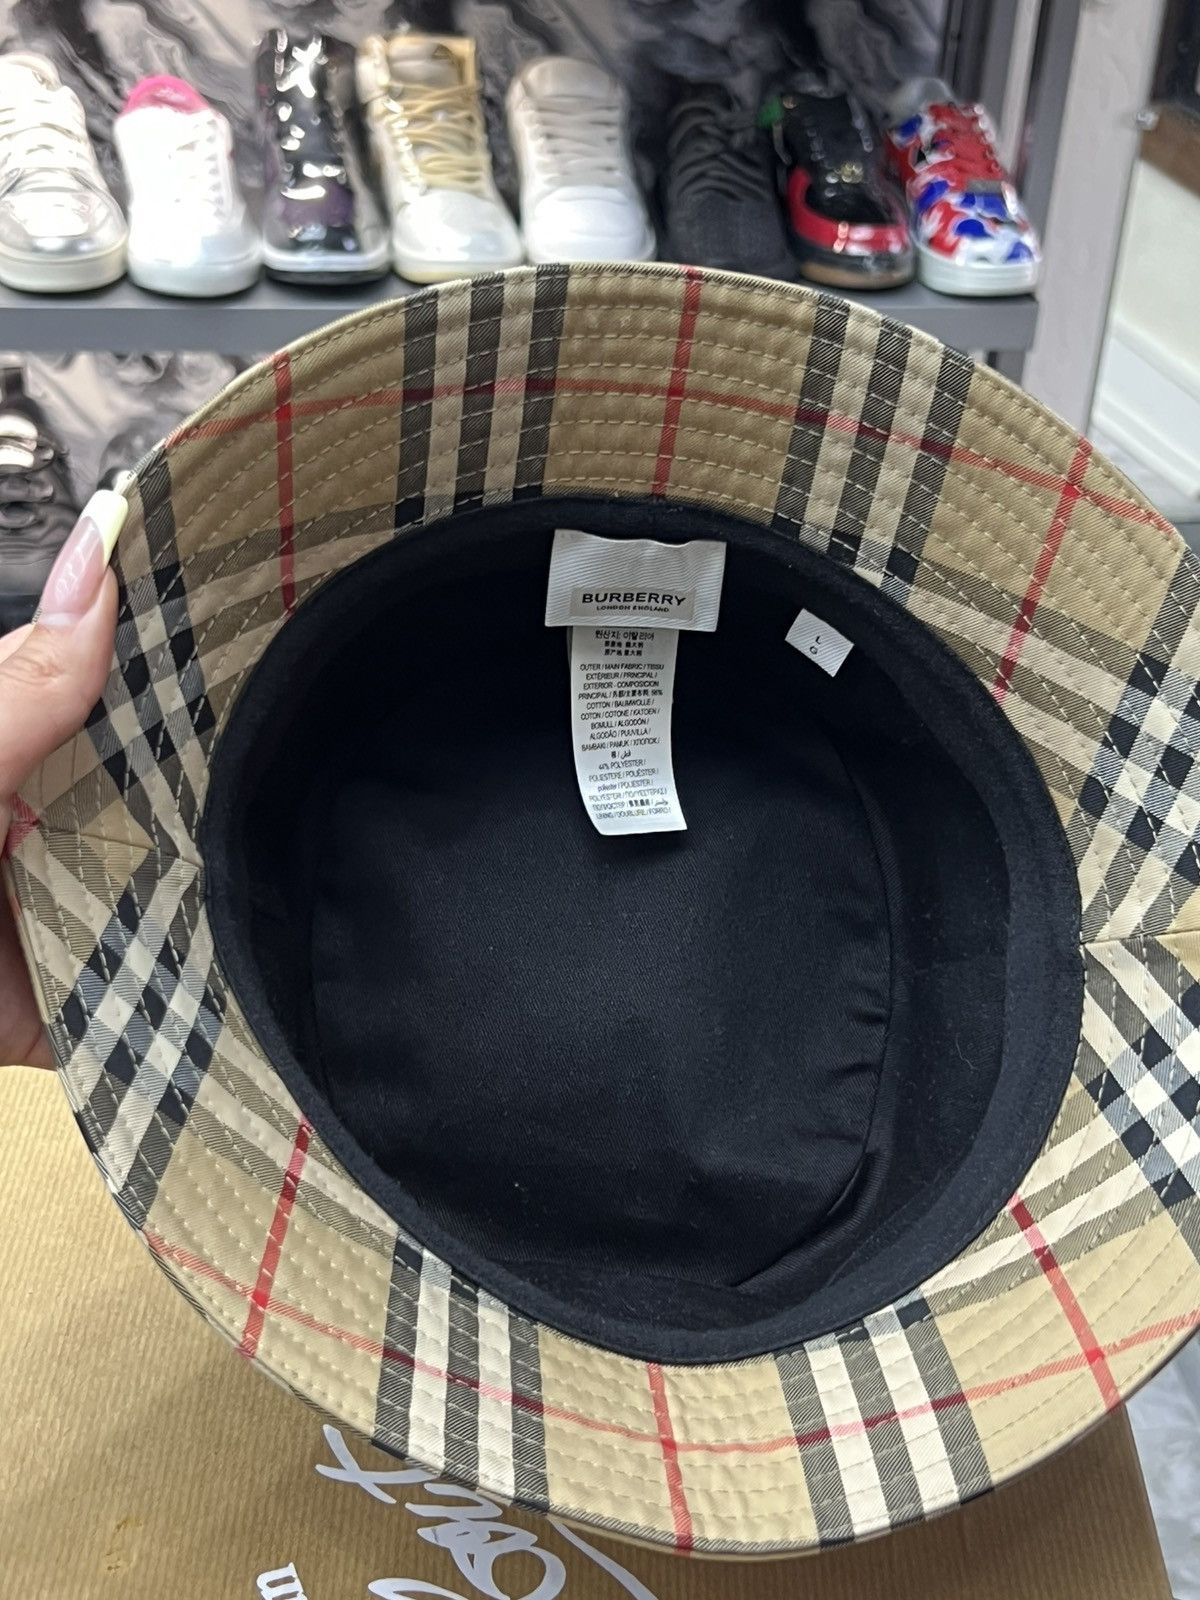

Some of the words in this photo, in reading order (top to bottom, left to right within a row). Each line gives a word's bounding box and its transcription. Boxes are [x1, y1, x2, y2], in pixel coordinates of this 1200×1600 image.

[582, 591, 687, 606] BURBERRY
[632, 605, 670, 613] ENGLAND
[815, 635, 822, 645] L
[578, 692, 608, 700] PRINCIPAL
[586, 701, 610, 710] COTTON
[580, 712, 601, 720] COTON
[605, 709, 629, 718] COTONE
[610, 759, 643, 769] POLYESTER
